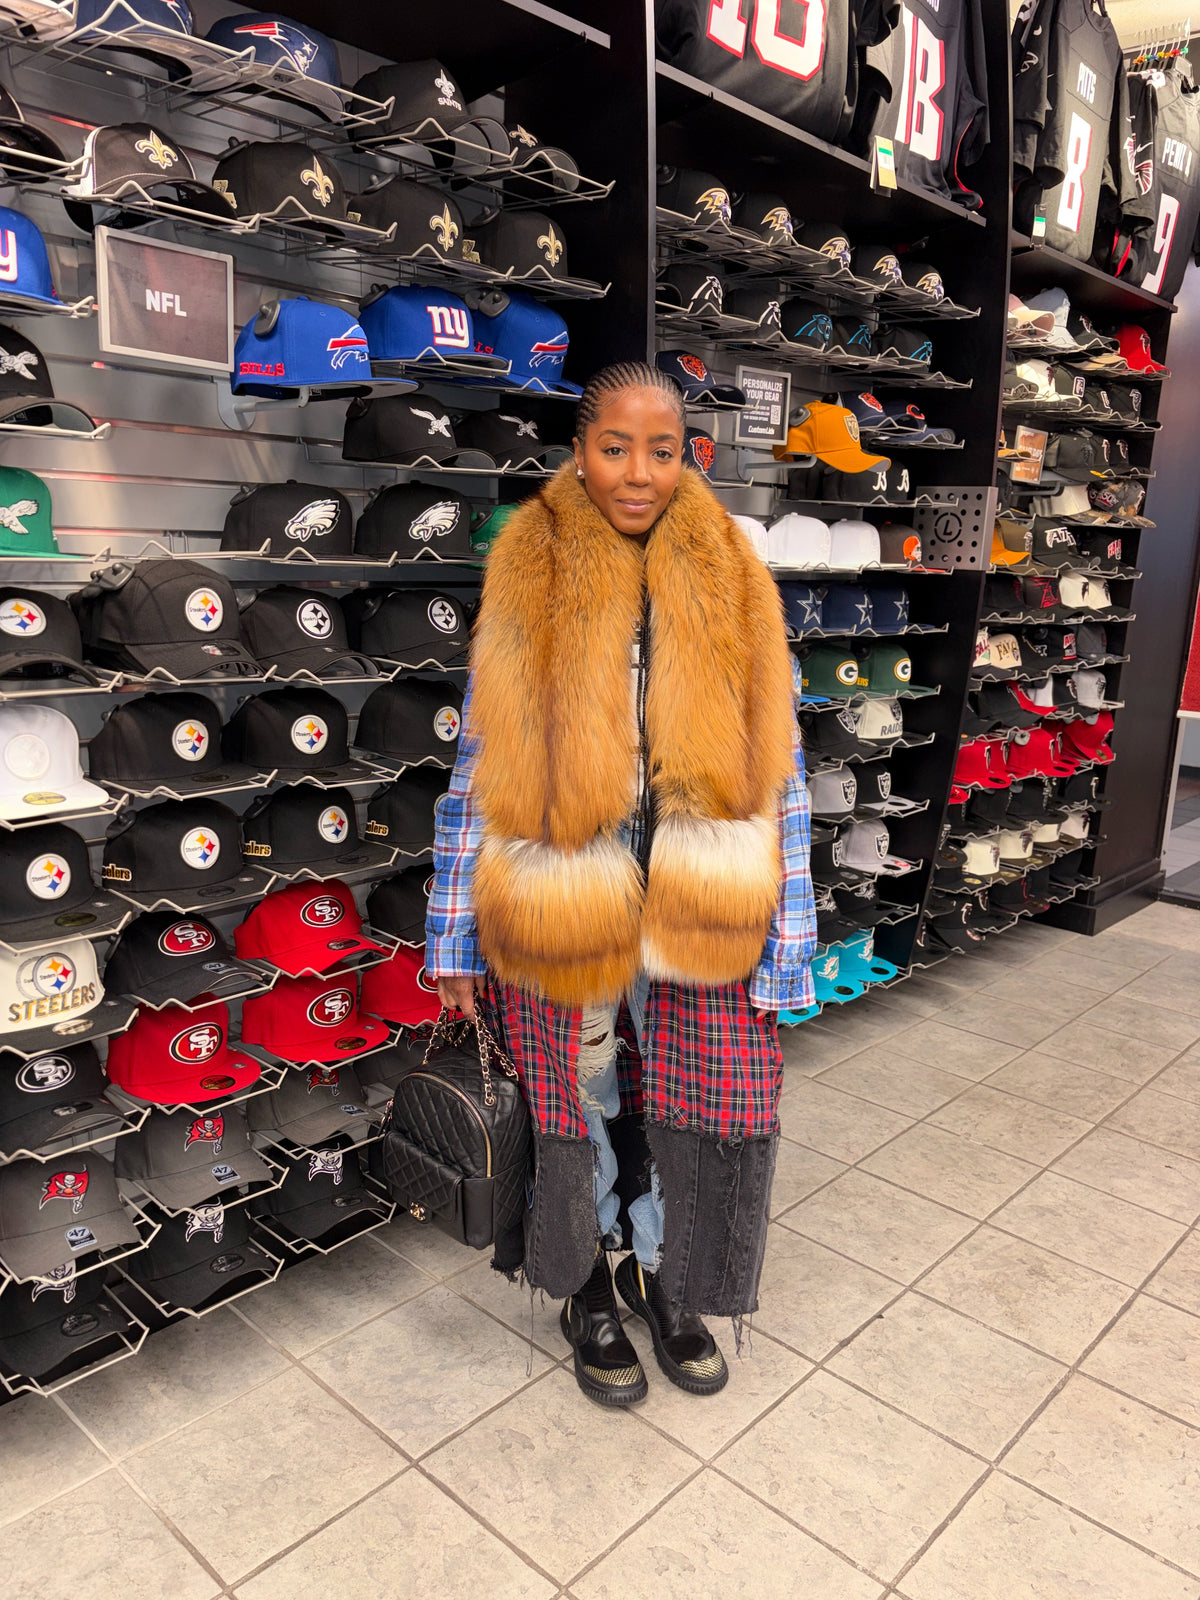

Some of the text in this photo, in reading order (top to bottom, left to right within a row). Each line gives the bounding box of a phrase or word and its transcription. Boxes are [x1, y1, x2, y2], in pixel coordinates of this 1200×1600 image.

[1057, 112, 1092, 233] 8
[145, 288, 187, 317] NFL
[239, 362, 285, 376] BILLS
[743, 378, 782, 392] PERSONALIZE
[746, 389, 779, 402] YOUR GEAR
[8, 982, 96, 1024] STEELERS
